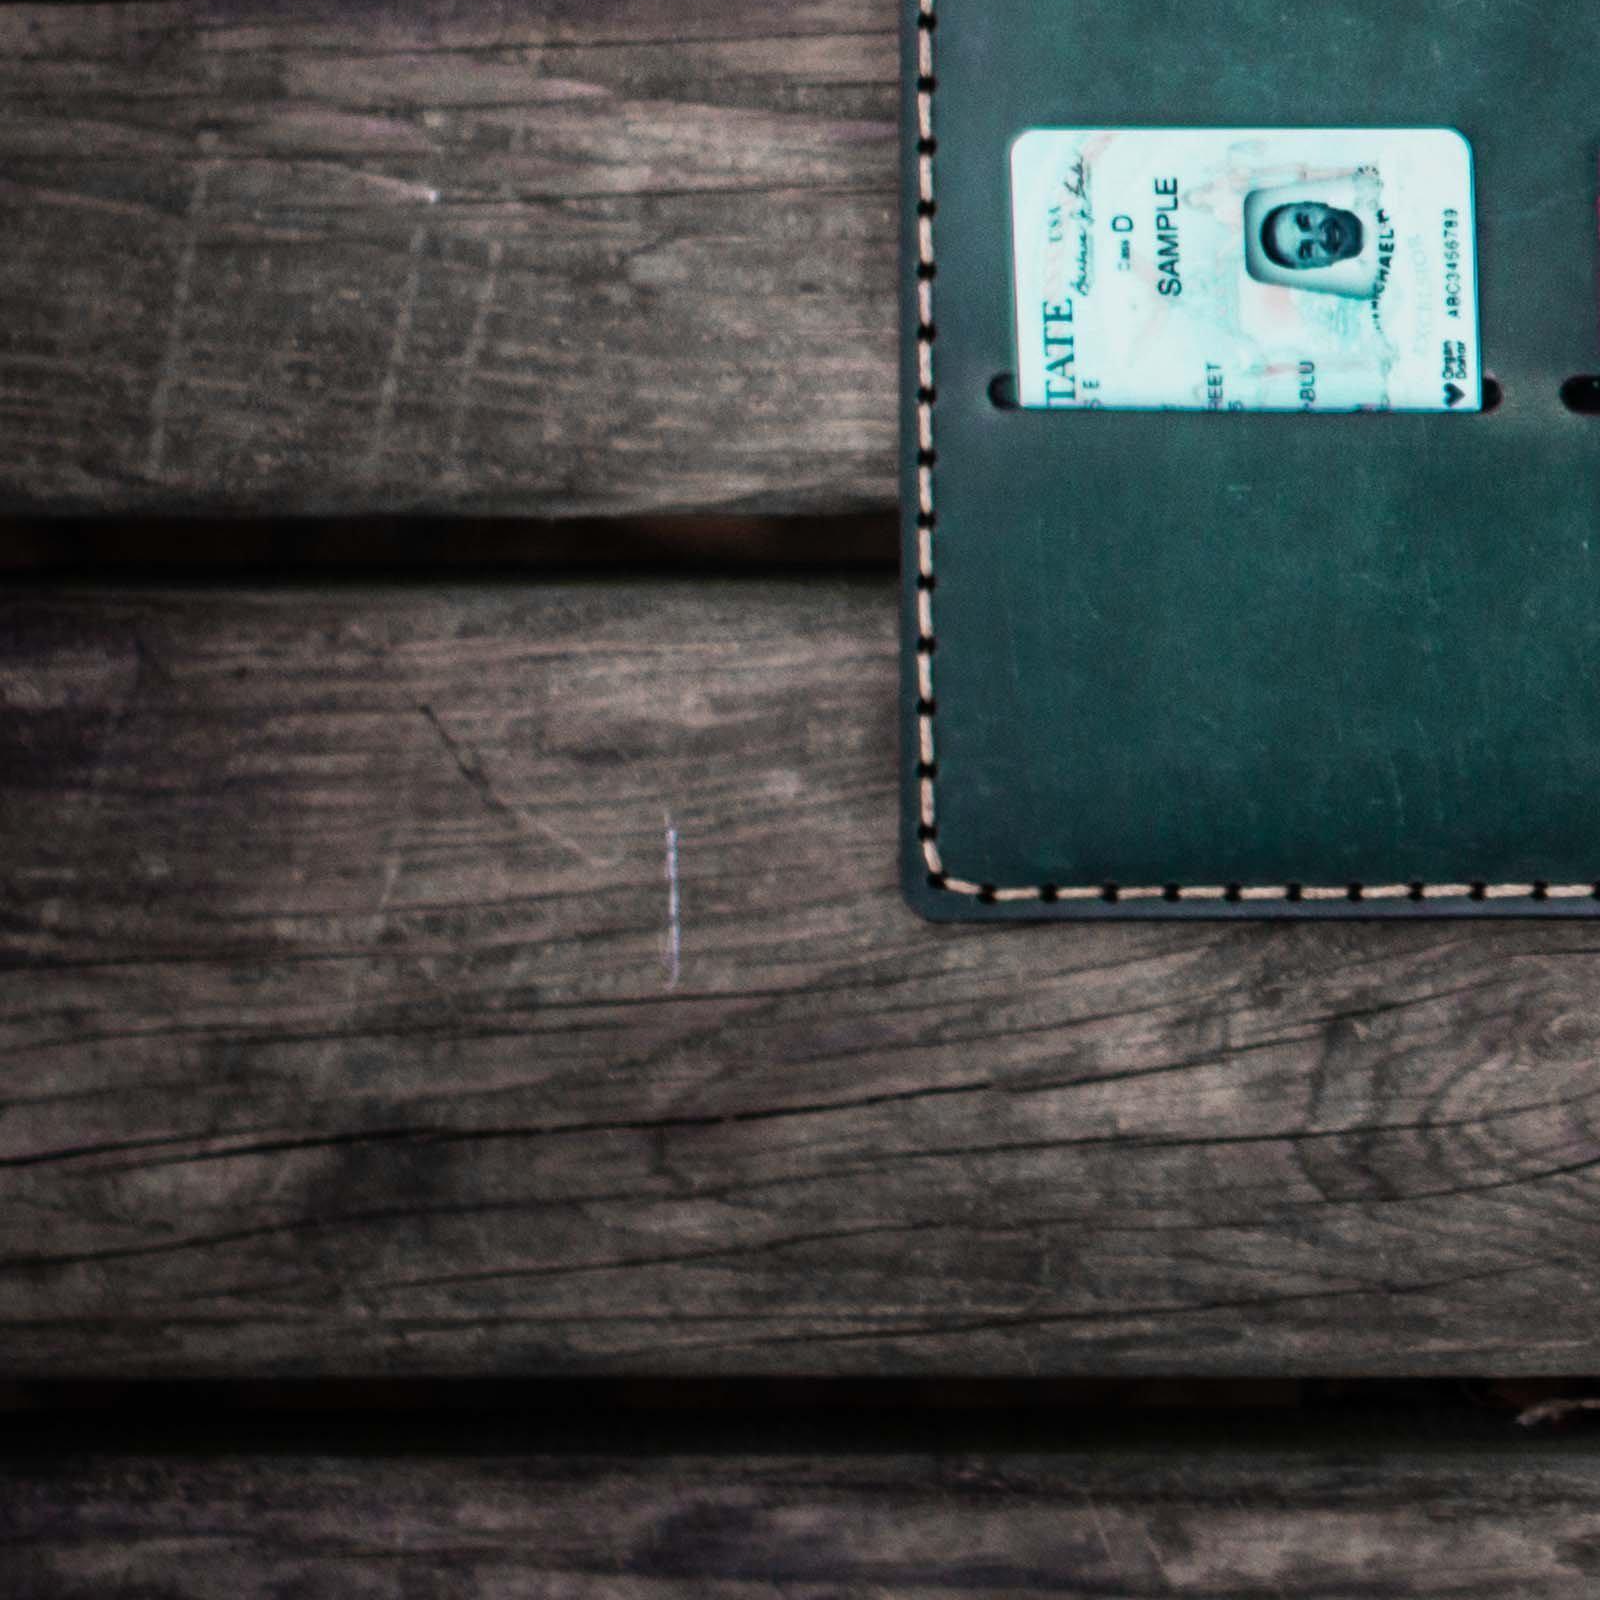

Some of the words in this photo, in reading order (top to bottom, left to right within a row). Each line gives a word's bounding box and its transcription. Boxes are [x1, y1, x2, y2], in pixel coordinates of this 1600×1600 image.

[1111, 214, 1134, 233] D
[1154, 176, 1183, 297] SAMPLE
[1042, 298, 1076, 408] TATE
